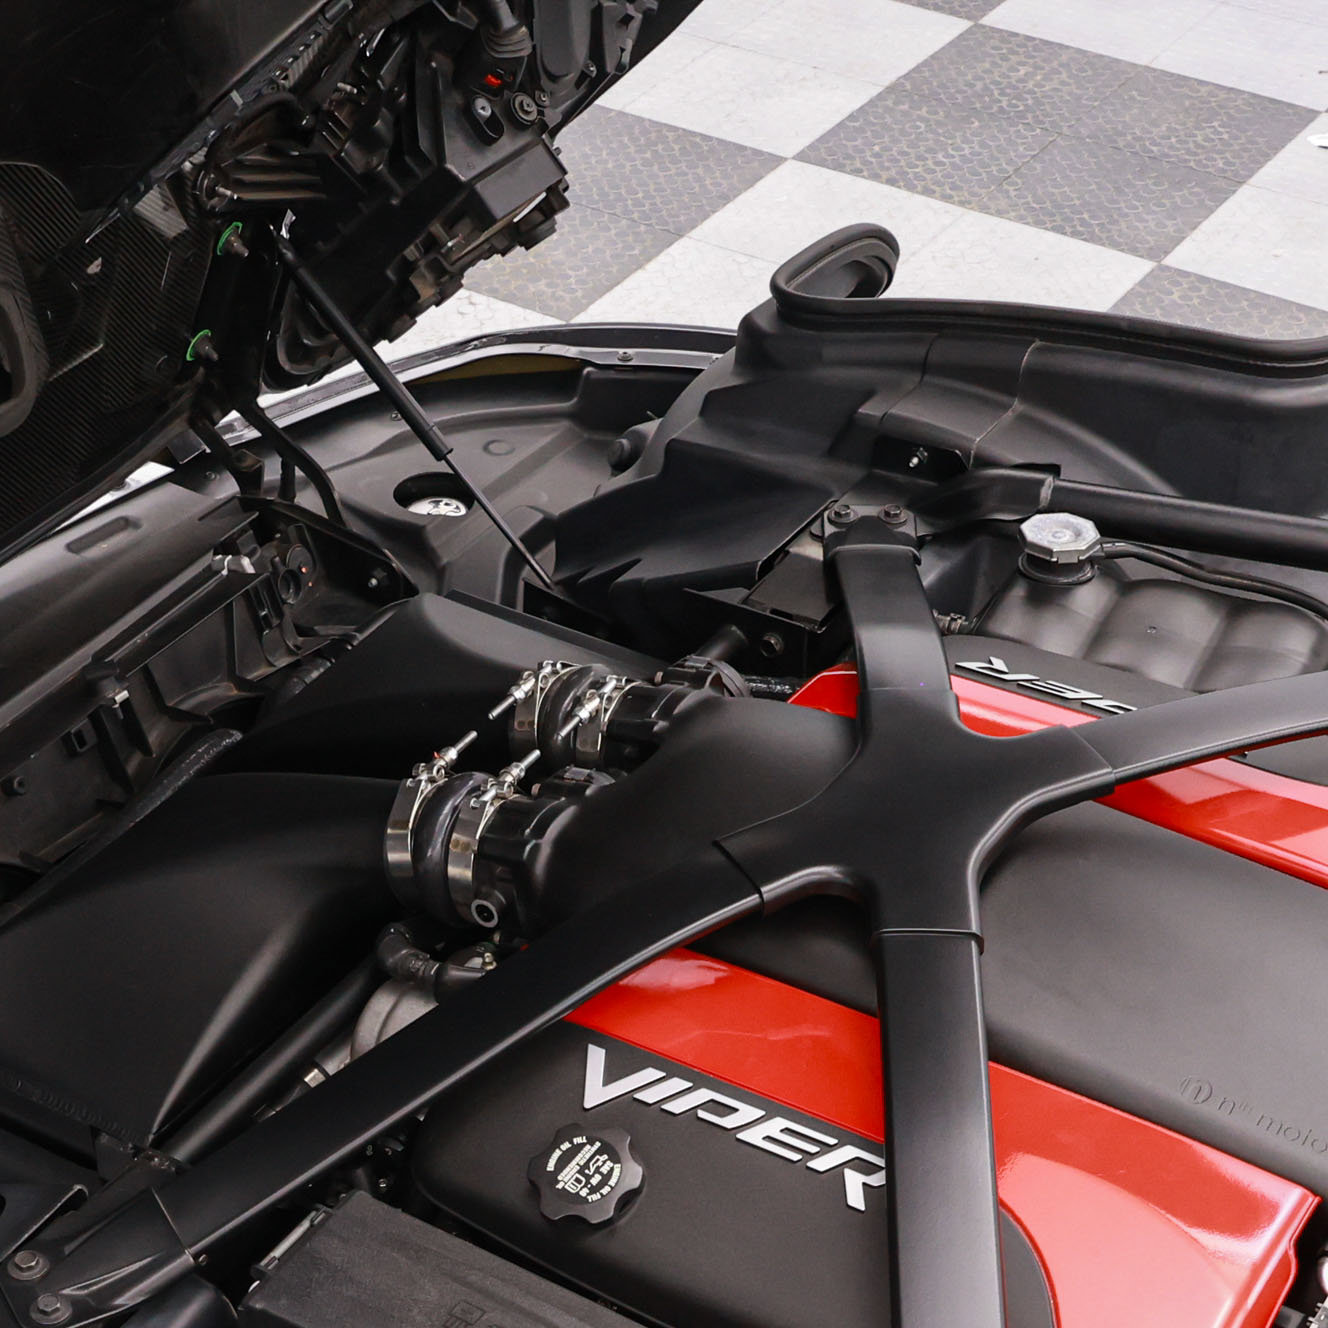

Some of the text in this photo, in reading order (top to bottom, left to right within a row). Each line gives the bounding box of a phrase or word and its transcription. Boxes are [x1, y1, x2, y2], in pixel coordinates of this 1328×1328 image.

[583, 1043, 886, 1212] VIPER
[573, 1136, 587, 1145] FILL
[599, 1160, 614, 1175] SAE
[586, 1192, 602, 1203] FILL
